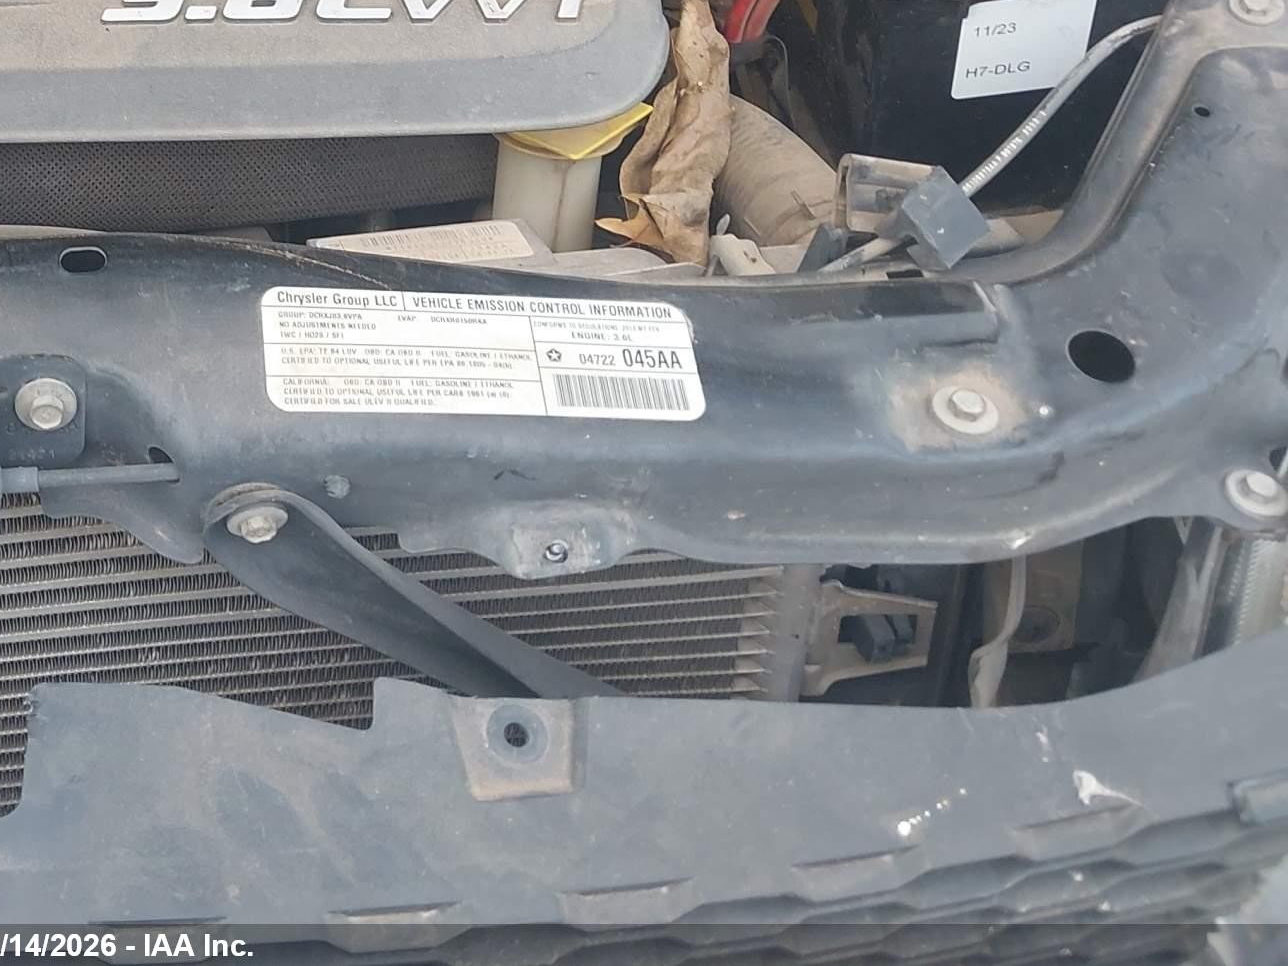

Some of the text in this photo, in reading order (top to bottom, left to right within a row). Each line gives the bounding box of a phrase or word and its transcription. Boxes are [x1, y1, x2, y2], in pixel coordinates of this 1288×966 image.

[974, 21, 1017, 38] 11/23
[965, 60, 1031, 79] H7-DLG
[277, 290, 398, 308] Chrysler Group LLC
[412, 297, 672, 319] VEHICLE EMISSION CONTROL INFORMATION
[279, 321, 376, 330] NO ADJUSTMENTS NEEDED
[281, 357, 319, 365] CERTIFIED
[321, 357, 331, 365] TO
[334, 357, 370, 365] OPTIONAL
[373, 358, 401, 366] USEFUL
[579, 348, 683, 370] 04722 045AA
[435, 380, 471, 388] GASOLINE
[284, 387, 322, 395] CERTIFIED
[325, 387, 334, 395] TO
[337, 388, 374, 396] OPTIONAL
[376, 388, 405, 396] USEFUL
[284, 397, 323, 405] CERTIFIED
[324, 397, 341, 405] FOR
